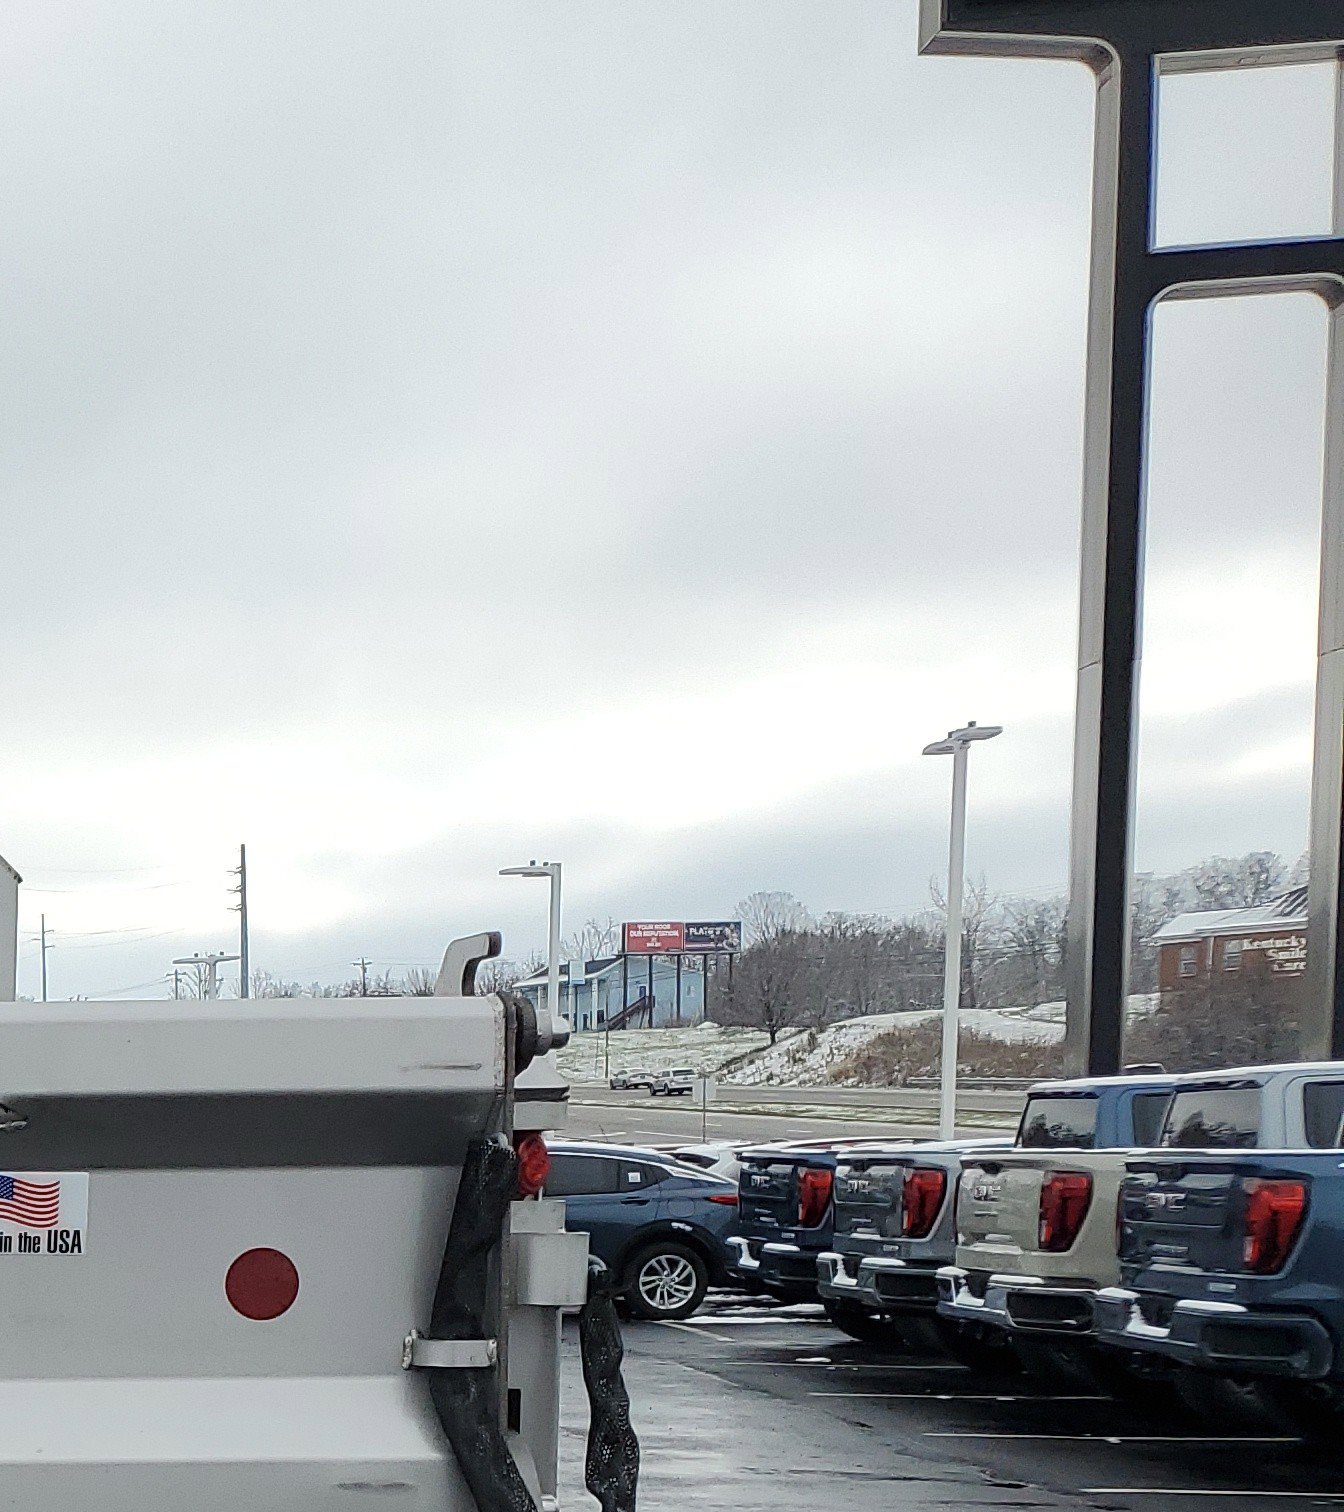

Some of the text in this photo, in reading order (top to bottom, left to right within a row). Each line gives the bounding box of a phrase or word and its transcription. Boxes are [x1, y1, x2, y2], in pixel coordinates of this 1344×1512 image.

[0, 1231, 13, 1253] in
[18, 1231, 41, 1253] the
[46, 1229, 83, 1254] USA
